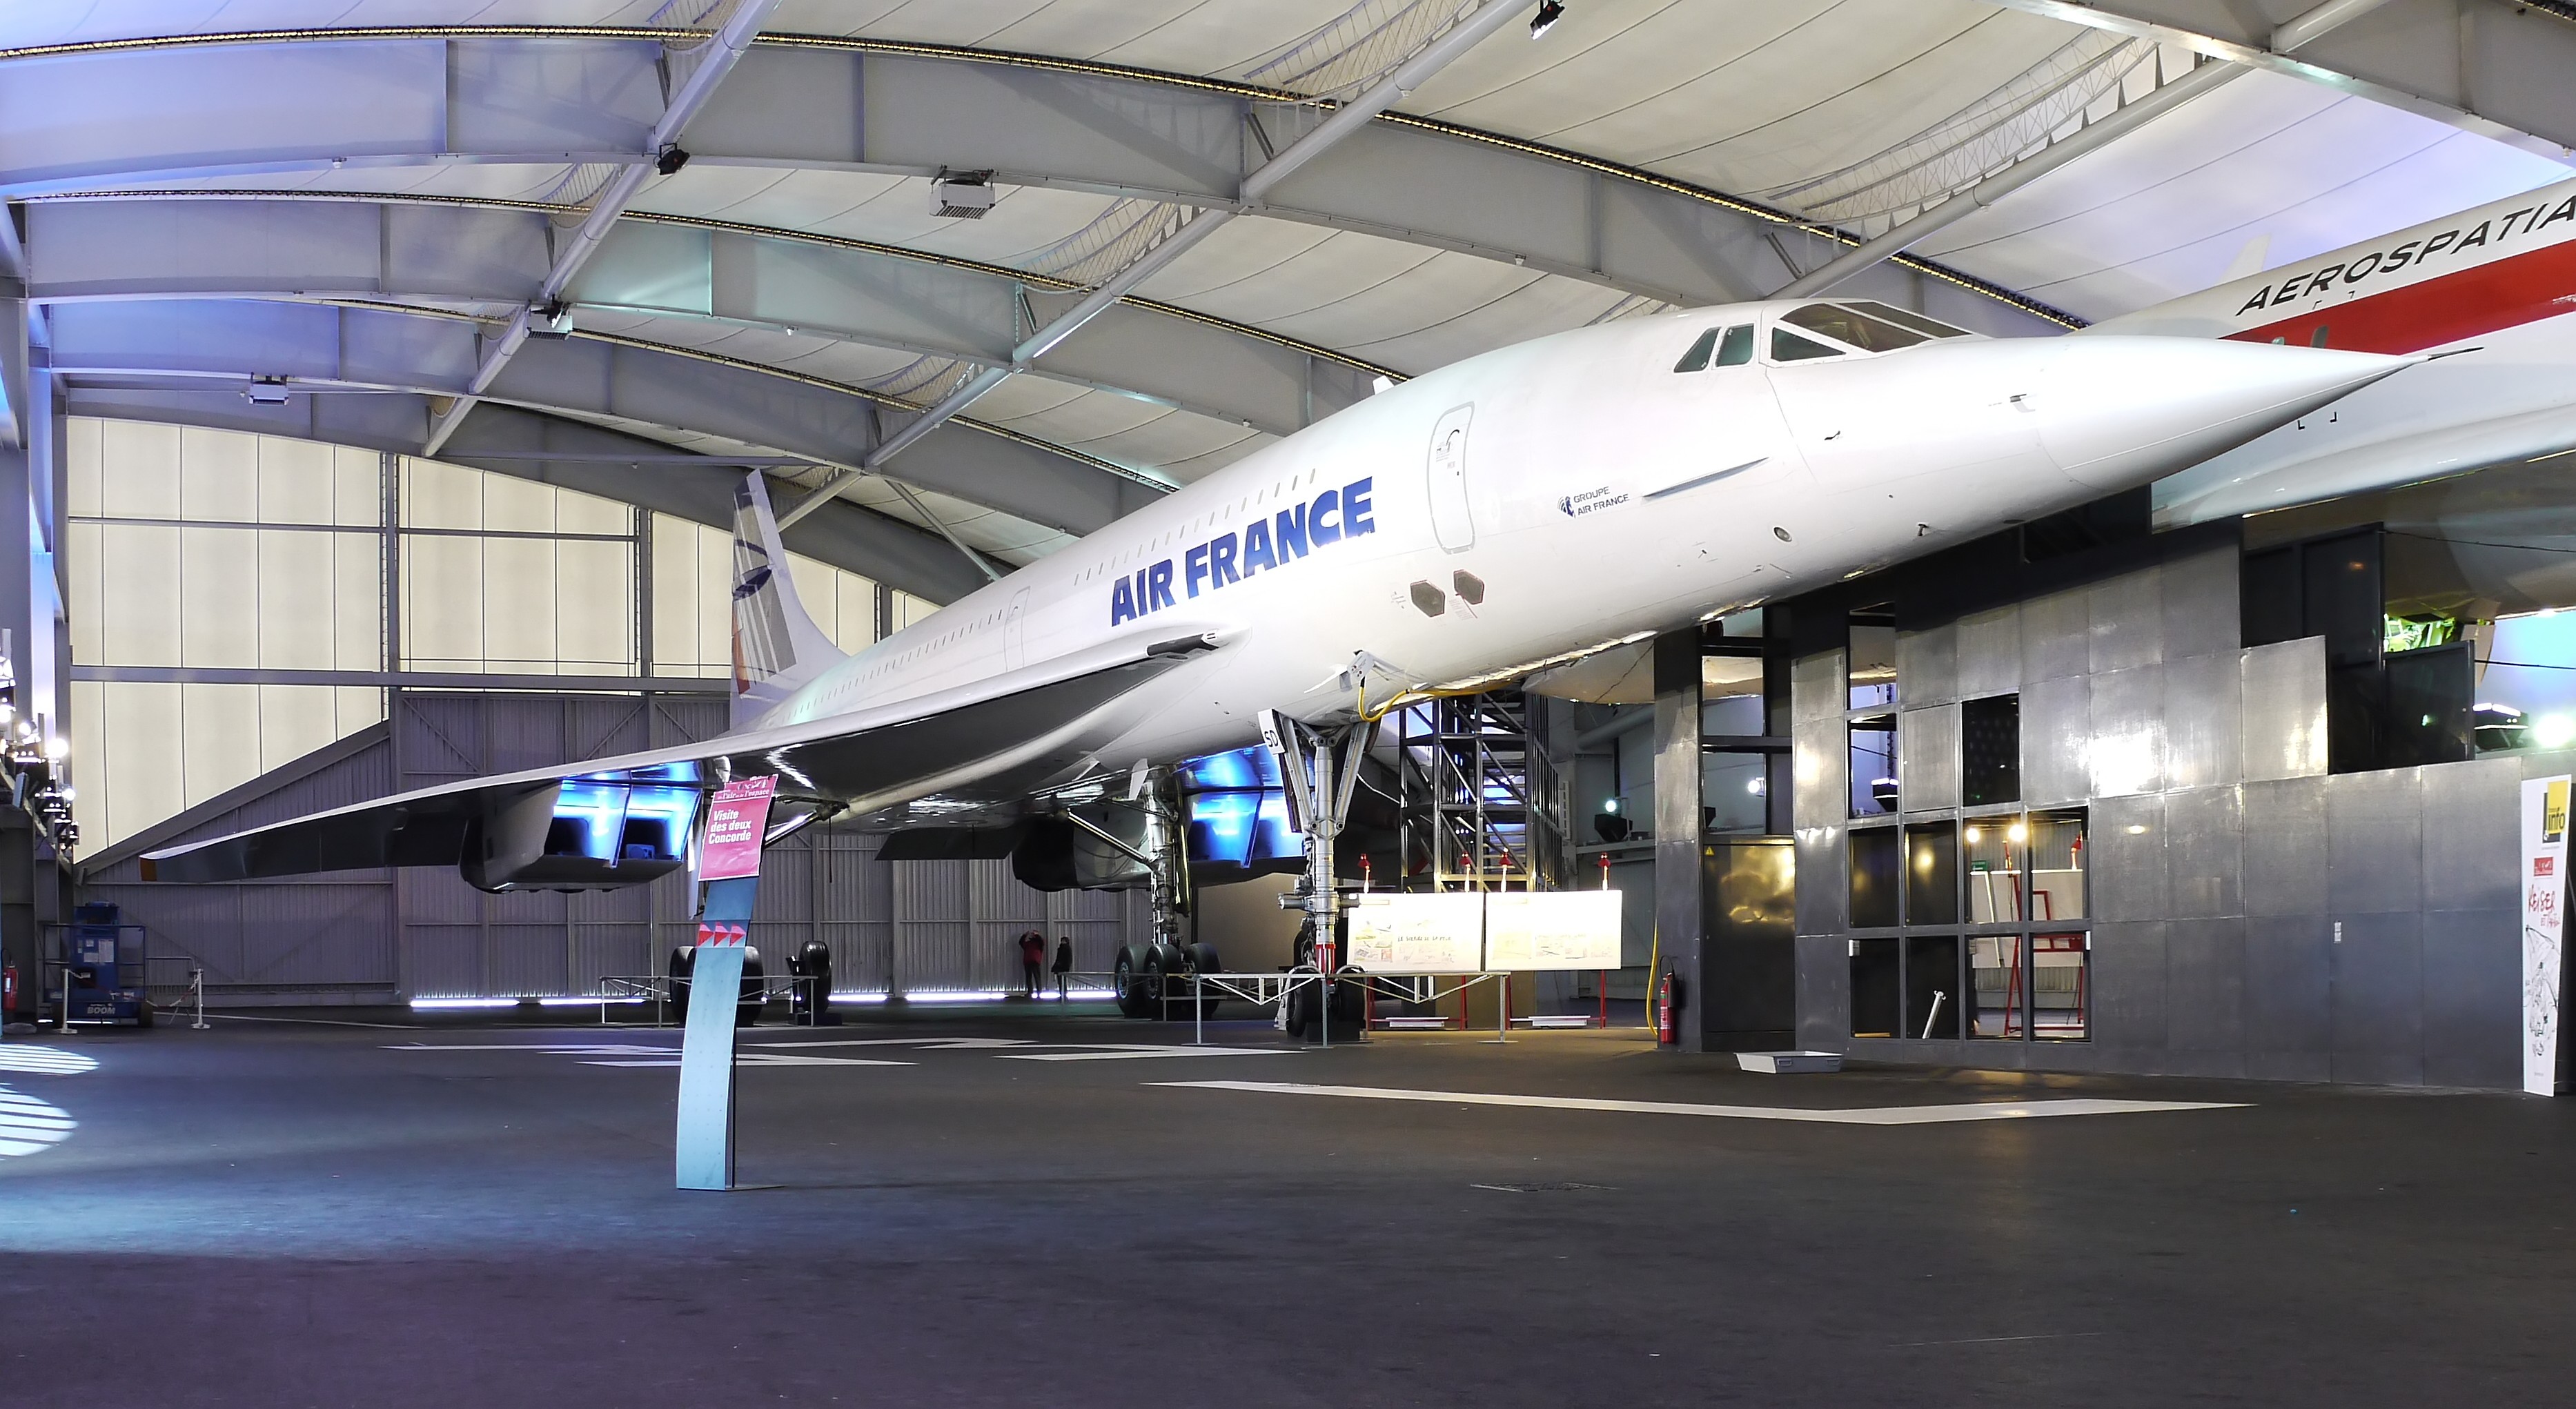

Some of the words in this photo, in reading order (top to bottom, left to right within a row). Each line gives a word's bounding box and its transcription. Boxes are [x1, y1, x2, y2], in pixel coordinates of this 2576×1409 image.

[1573, 486, 1611, 503] GROUPE
[1577, 504, 1592, 515] AIR
[1593, 493, 1630, 511] FRANCE
[1112, 558, 1176, 627] AIR
[1186, 476, 1375, 599] FRANCE
[1264, 729, 1279, 747] SD
[714, 809, 739, 821] Visite
[710, 821, 727, 832] des
[728, 819, 751, 831] deux
[708, 829, 751, 844] Concorde
